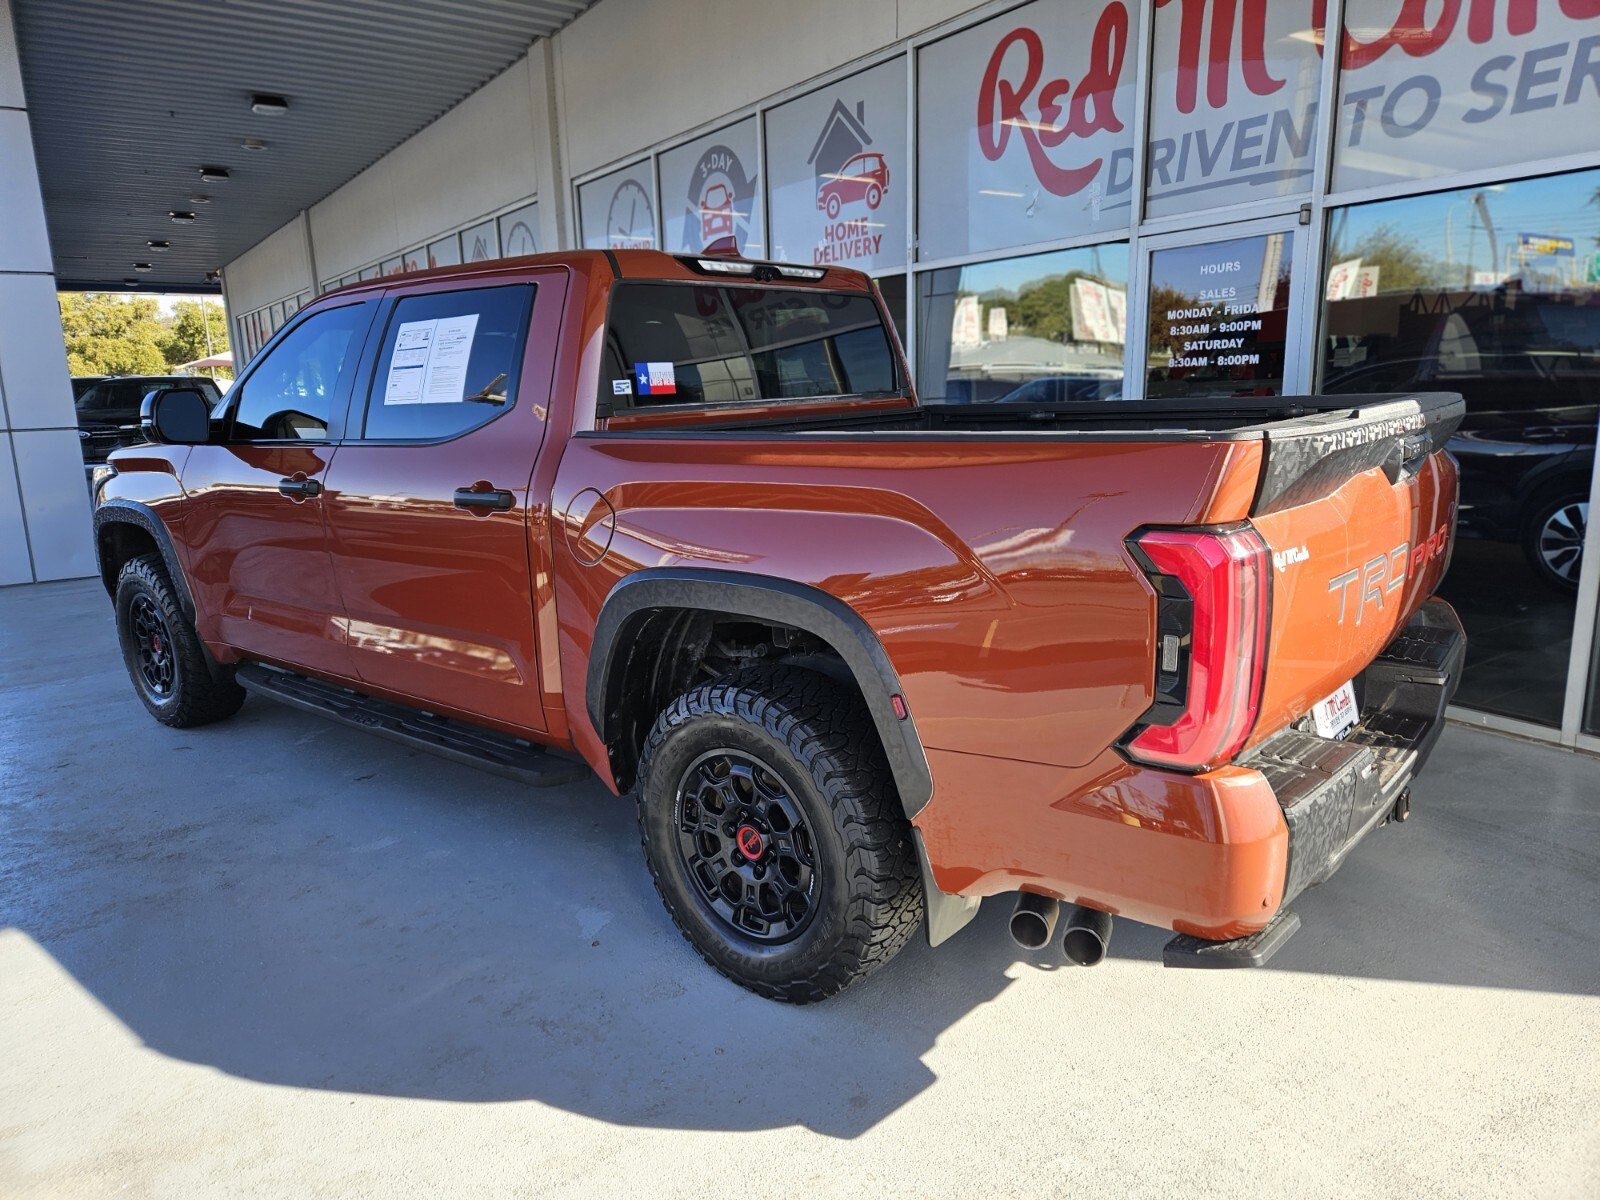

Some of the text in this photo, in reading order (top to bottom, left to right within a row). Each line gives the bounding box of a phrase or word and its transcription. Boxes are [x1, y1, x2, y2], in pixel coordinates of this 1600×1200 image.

[978, 1, 1128, 197] Red
[1106, 102, 1318, 197] DRIVEN
[1343, 75, 1442, 147] TO
[700, 153, 732, 178] 3-DAY
[825, 217, 868, 242] HOME
[814, 234, 882, 266] DELIVERY
[1200, 261, 1241, 275] HOURS
[1200, 287, 1236, 300] SALES
[1167, 307, 1214, 320] MONDAY
[1170, 324, 1209, 336] 8:30AM
[1219, 320, 1262, 333] 9:00PM
[1184, 338, 1244, 351] SATURDAY
[1168, 356, 1208, 368] 8:30AM
[1217, 354, 1260, 366] 8:00PM
[1328, 542, 1409, 627] TRD
